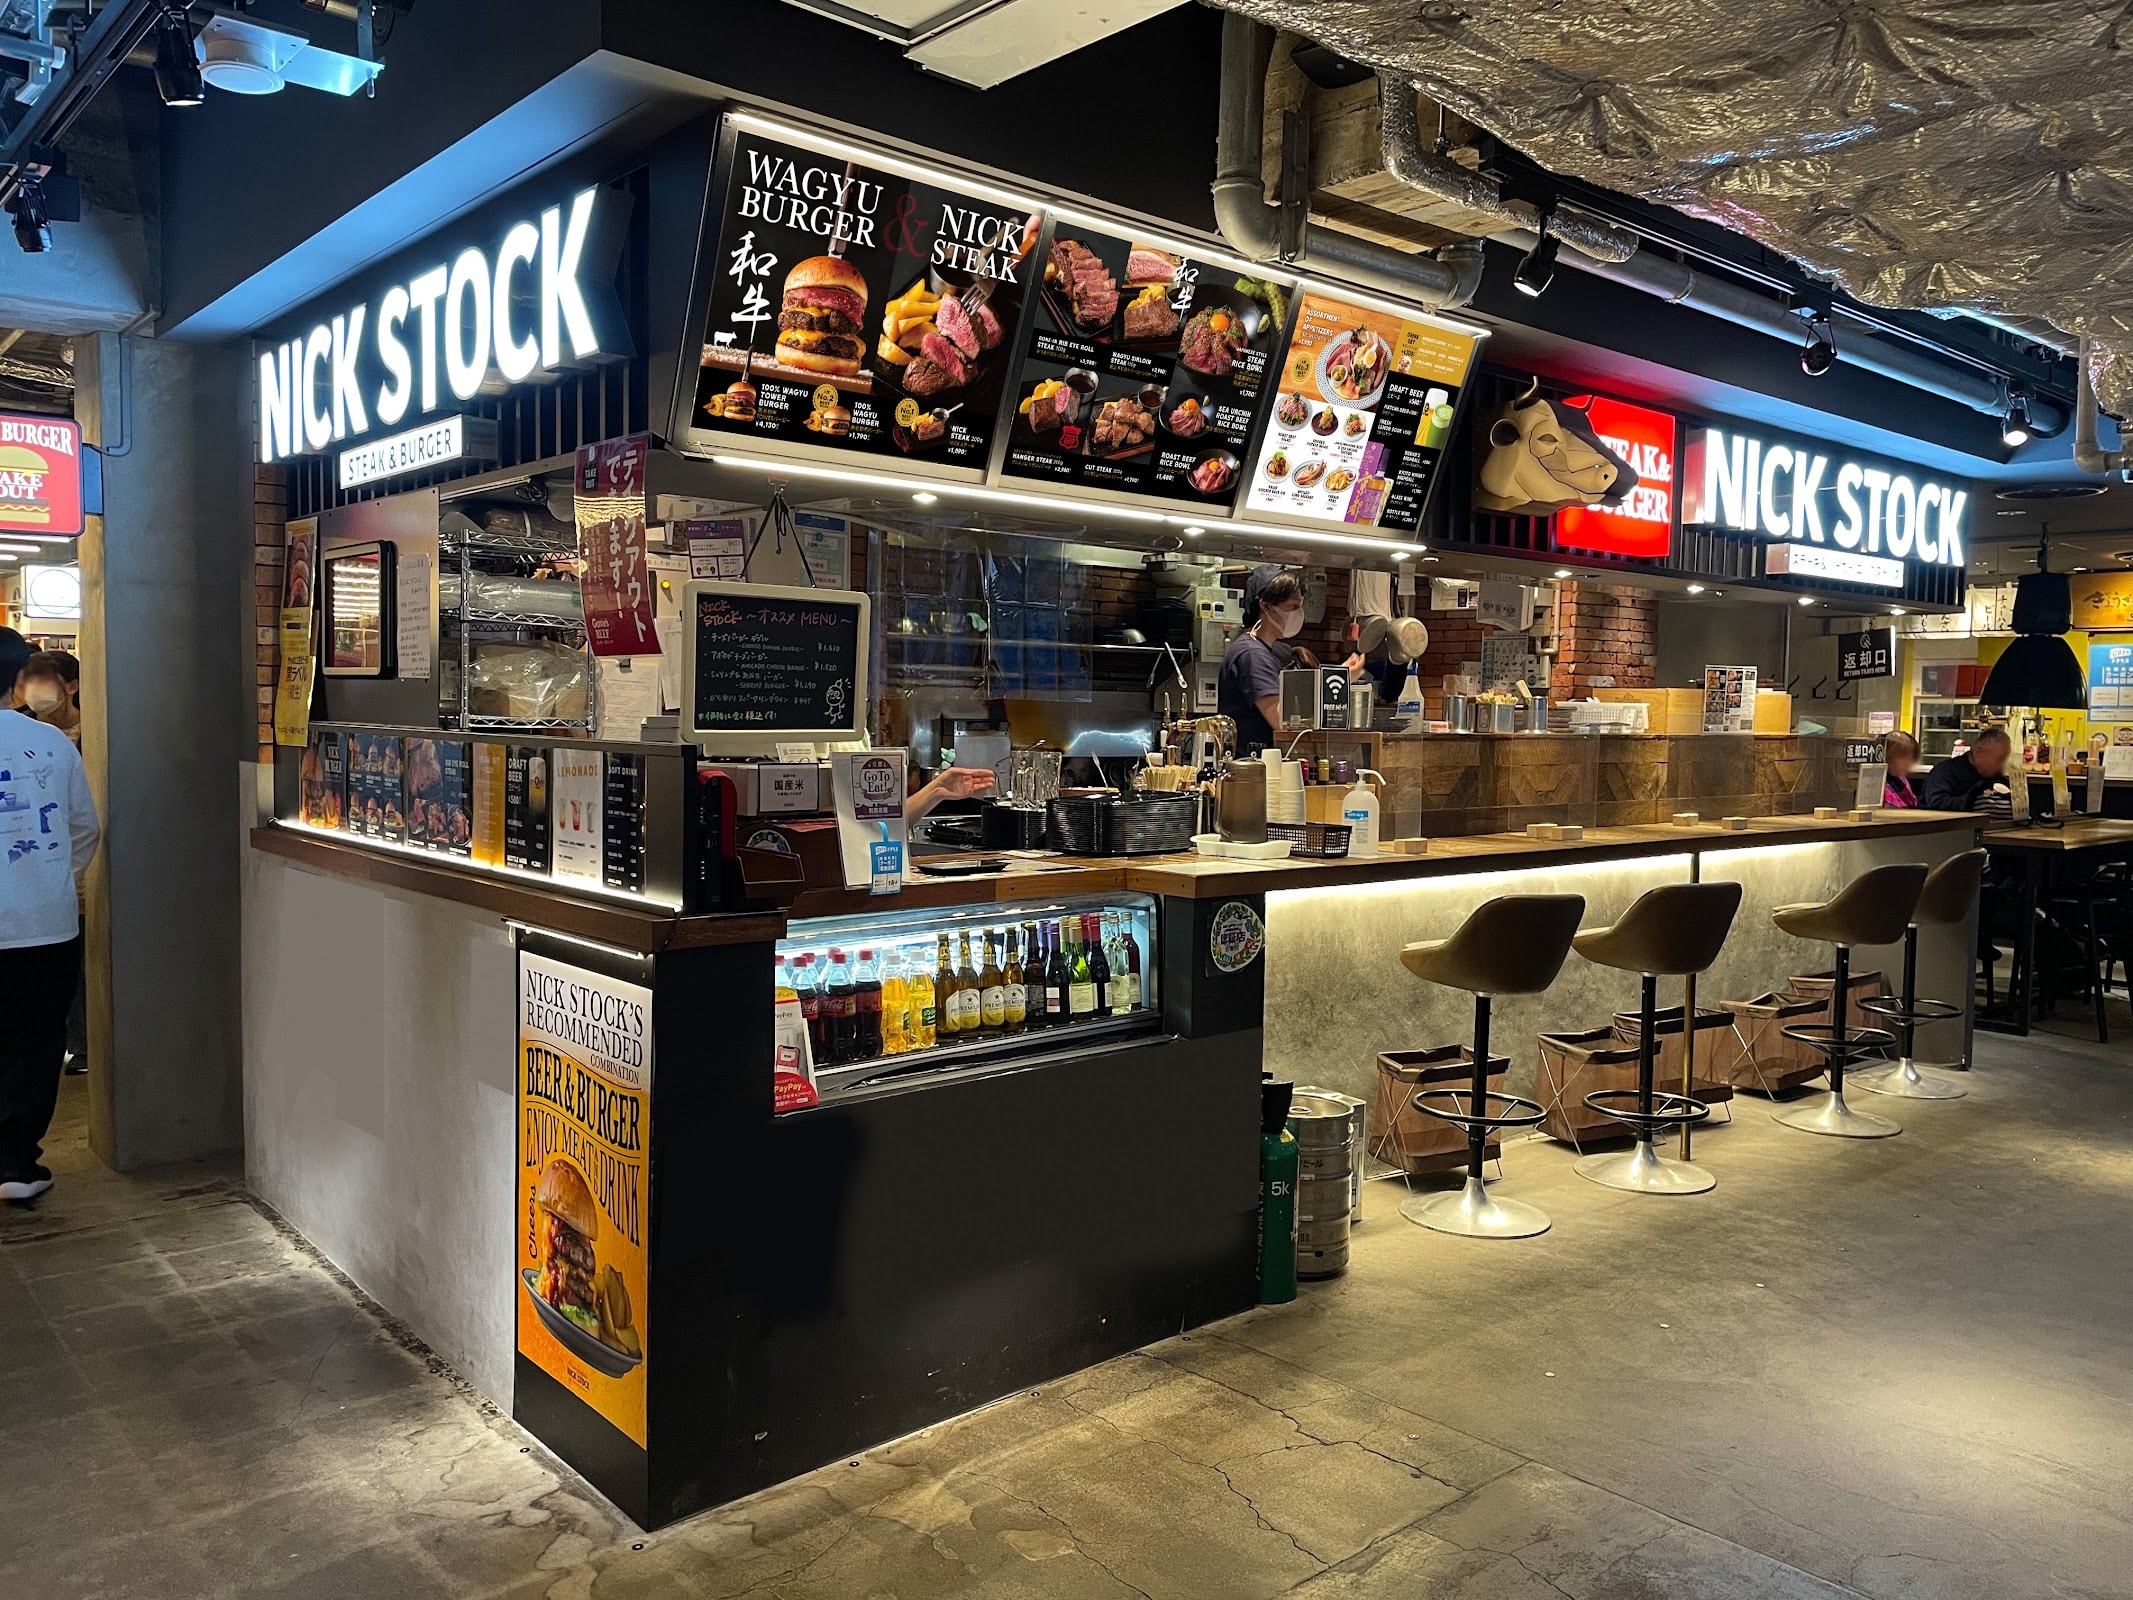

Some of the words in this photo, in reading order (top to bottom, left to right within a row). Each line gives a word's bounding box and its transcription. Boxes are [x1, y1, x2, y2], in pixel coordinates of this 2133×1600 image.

[747, 150, 884, 215] WAGYU
[738, 186, 876, 248] BURGER
[883, 194, 928, 258] &
[937, 204, 1024, 255] NICK
[931, 239, 1020, 284] STEAK
[729, 231, 779, 344] 和牛
[1307, 309, 1341, 322] ASSORTMENT
[260, 303, 369, 463] NICK
[377, 184, 600, 425] STOCK
[1303, 324, 1333, 336] APPETIZERS
[1037, 342, 1054, 350] STEAK
[1059, 339, 1068, 347] RIB
[1069, 342, 1079, 350] EYE
[1080, 344, 1094, 352] ROLL
[1111, 358, 1127, 366] STEAK
[1112, 352, 1131, 361] WAGYU
[1132, 355, 1152, 365] SIRLOIN
[1247, 356, 1266, 365] STEAK
[1232, 360, 1246, 369] RICE
[1247, 363, 1263, 373] BOWL
[760, 391, 787, 402] TOWER
[761, 384, 781, 393] 100%
[782, 386, 808, 398] WAGYU
[1389, 384, 1409, 394] DRAFT
[1409, 389, 1424, 398] BEER
[816, 393, 834, 402] No.2
[759, 400, 789, 410] BURGER
[854, 402, 872, 410] 100%
[900, 407, 914, 415] No.1
[853, 409, 878, 419] WAGYU
[1216, 413, 1235, 421] ROAST
[1231, 408, 1251, 417] URCHIN
[852, 417, 880, 427] BURGER
[1217, 420, 1230, 428] RICE
[1231, 423, 1247, 431] BOWL
[952, 425, 968, 433] NICK
[1, 421, 74, 456] BURGER
[951, 433, 970, 441] STEAK
[348, 448, 387, 481] STEAK
[388, 445, 398, 468] &
[400, 427, 453, 467] BURGER
[1012, 453, 1035, 462] HANGER
[1036, 456, 1052, 464] STEAK
[1161, 452, 1181, 461] ROAST
[1182, 455, 1196, 463] BEEF
[1160, 459, 1173, 467] RICE
[1174, 462, 1191, 470] BOWL
[585, 467, 597, 479] TAKE
[585, 478, 595, 489] OUT
[1704, 428, 1829, 542] NICK
[1834, 462, 1968, 567] STOCK
[703, 610, 743, 627] STOCK
[800, 611, 838, 626] MENU
[1843, 649, 1886, 669] 返却口
[1846, 745, 1868, 757] 返却口
[508, 758, 527, 770] DRAFT
[508, 771, 523, 783] BEER
[558, 765, 598, 778] LEMONADE
[608, 766, 620, 775] SOFT
[622, 767, 638, 777] DRINK
[774, 779, 804, 791] 国産米
[868, 781, 887, 792] Eat!
[526, 968, 565, 1010] NICK
[570, 983, 643, 1037] STOCK'S
[526, 1000, 643, 1067] RECOMMENDED
[590, 1053, 639, 1085] COMBINATION
[526, 1047, 562, 1105] BEER
[565, 1062, 575, 1116] &
[577, 1069, 640, 1151] BURGER
[525, 1107, 559, 1176] ENJOY
[562, 1121, 593, 1183] MEAT
[599, 1150, 640, 1248] DRINK
[529, 1183, 537, 1260] Cheers
